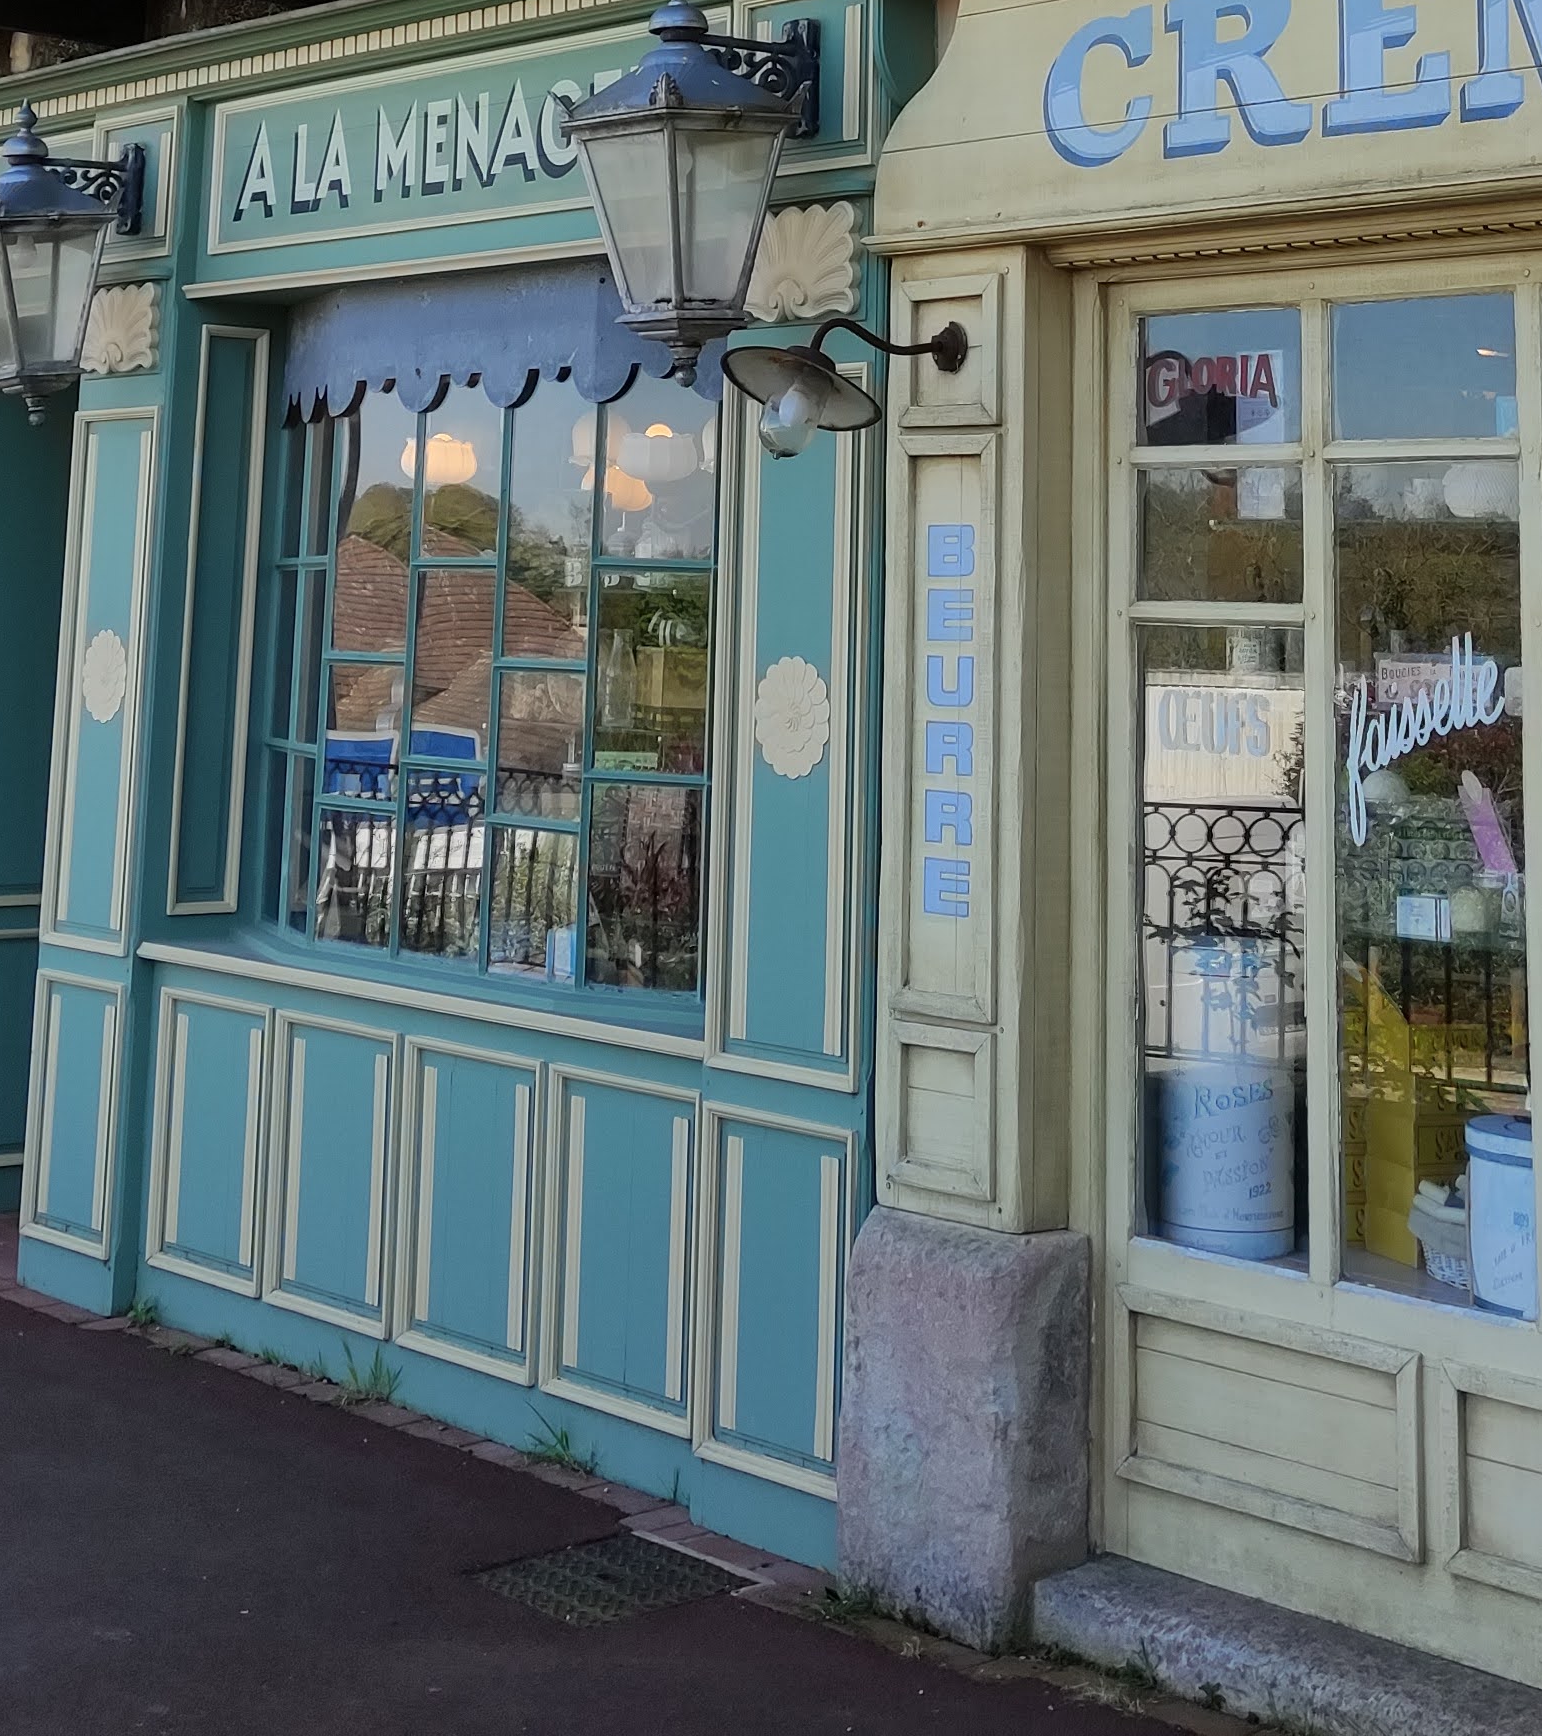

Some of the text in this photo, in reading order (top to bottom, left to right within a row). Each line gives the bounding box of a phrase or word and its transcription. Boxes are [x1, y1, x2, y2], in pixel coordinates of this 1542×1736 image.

[233, 71, 609, 221] A LA MENAG
[1147, 354, 1278, 408] GLORIA
[924, 524, 975, 918] BEURRE
[1194, 1079, 1273, 1119] ROSES
[1248, 1182, 1273, 1200] 1922
